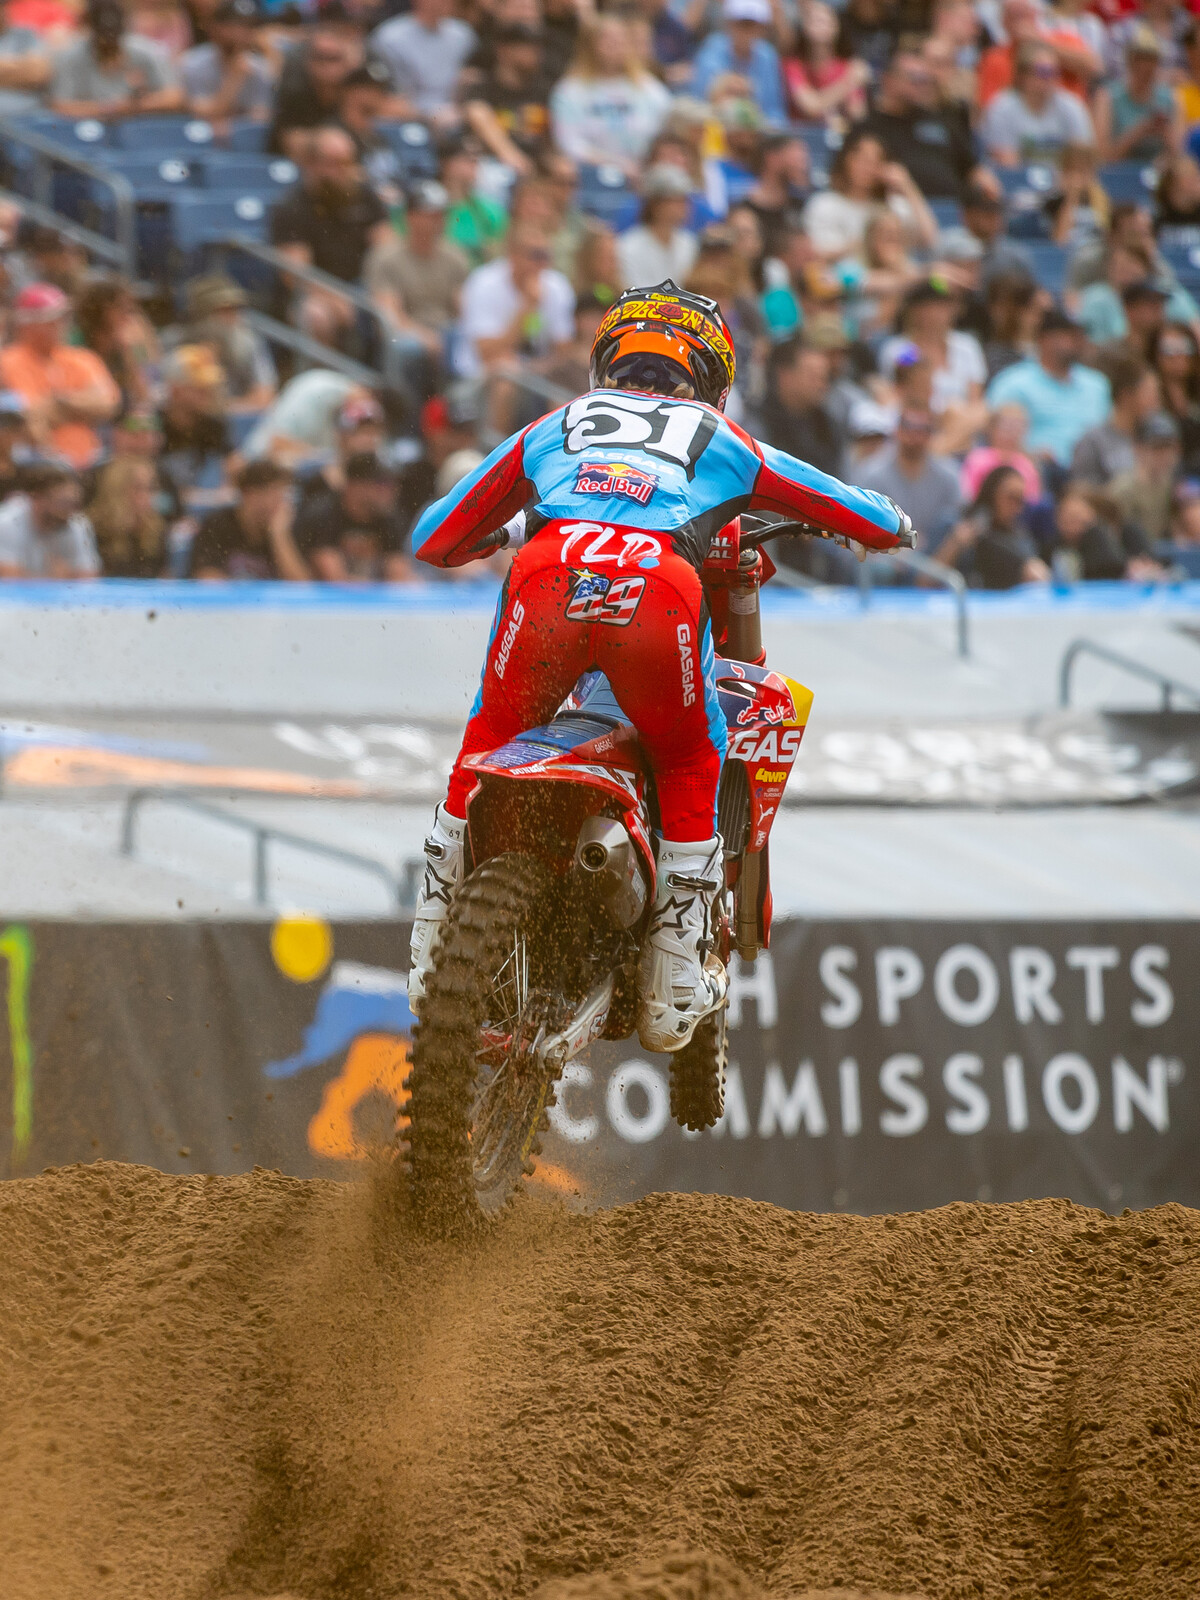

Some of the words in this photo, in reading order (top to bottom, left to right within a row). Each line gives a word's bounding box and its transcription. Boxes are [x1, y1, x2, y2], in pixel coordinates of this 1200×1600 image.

[566, 394, 705, 467] 51
[576, 450, 676, 476] GASGAS
[574, 477, 613, 493] Red
[613, 476, 653, 503] Bull
[559, 521, 663, 568] TLD
[566, 576, 646, 627] 69
[494, 599, 525, 680] GASGAS
[676, 623, 696, 708] GASGAS
[594, 738, 613, 754] GASGAS
[727, 730, 801, 763] GAS
[755, 767, 788, 783] 4WP
[449, 829, 461, 840] 69
[661, 851, 674, 862] 69
[819, 943, 1174, 1029] SPORTS
